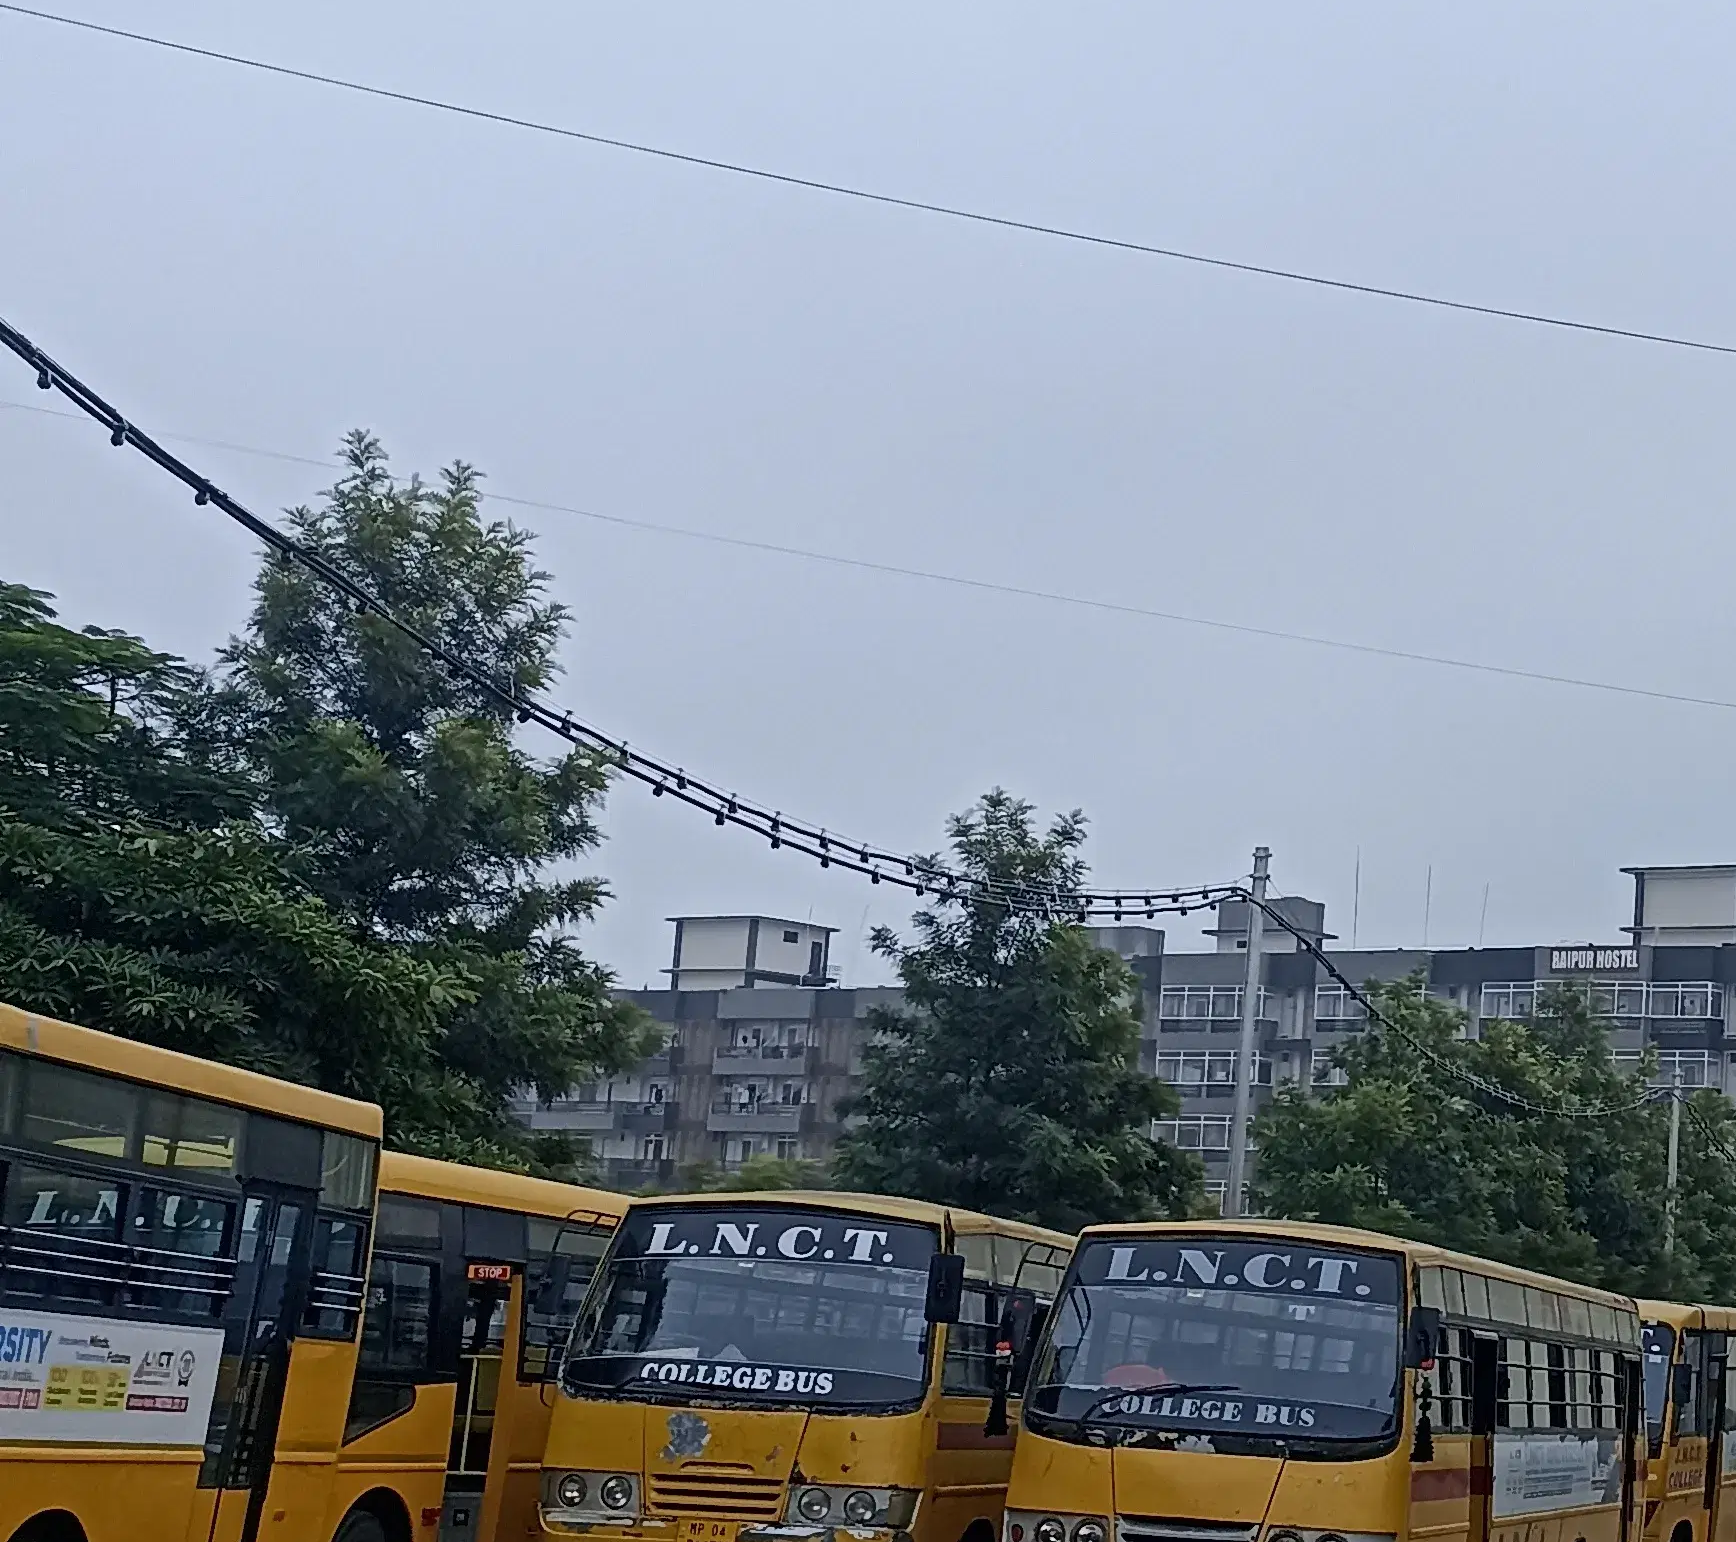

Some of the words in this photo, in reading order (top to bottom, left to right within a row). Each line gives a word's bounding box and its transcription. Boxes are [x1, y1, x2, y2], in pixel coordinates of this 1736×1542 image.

[1596, 949, 1638, 969] HOSTEL
[644, 1223, 894, 1263] L.N.C.T.
[478, 1268, 503, 1278] STOP
[1104, 1247, 1371, 1296] L.N.C.T.
[640, 1362, 773, 1390] COLLEGE
[775, 1370, 833, 1394] BUS
[1101, 1394, 1243, 1422] COLLEGE
[1255, 1403, 1316, 1427] BUS
[689, 1522, 704, 1535] MP
